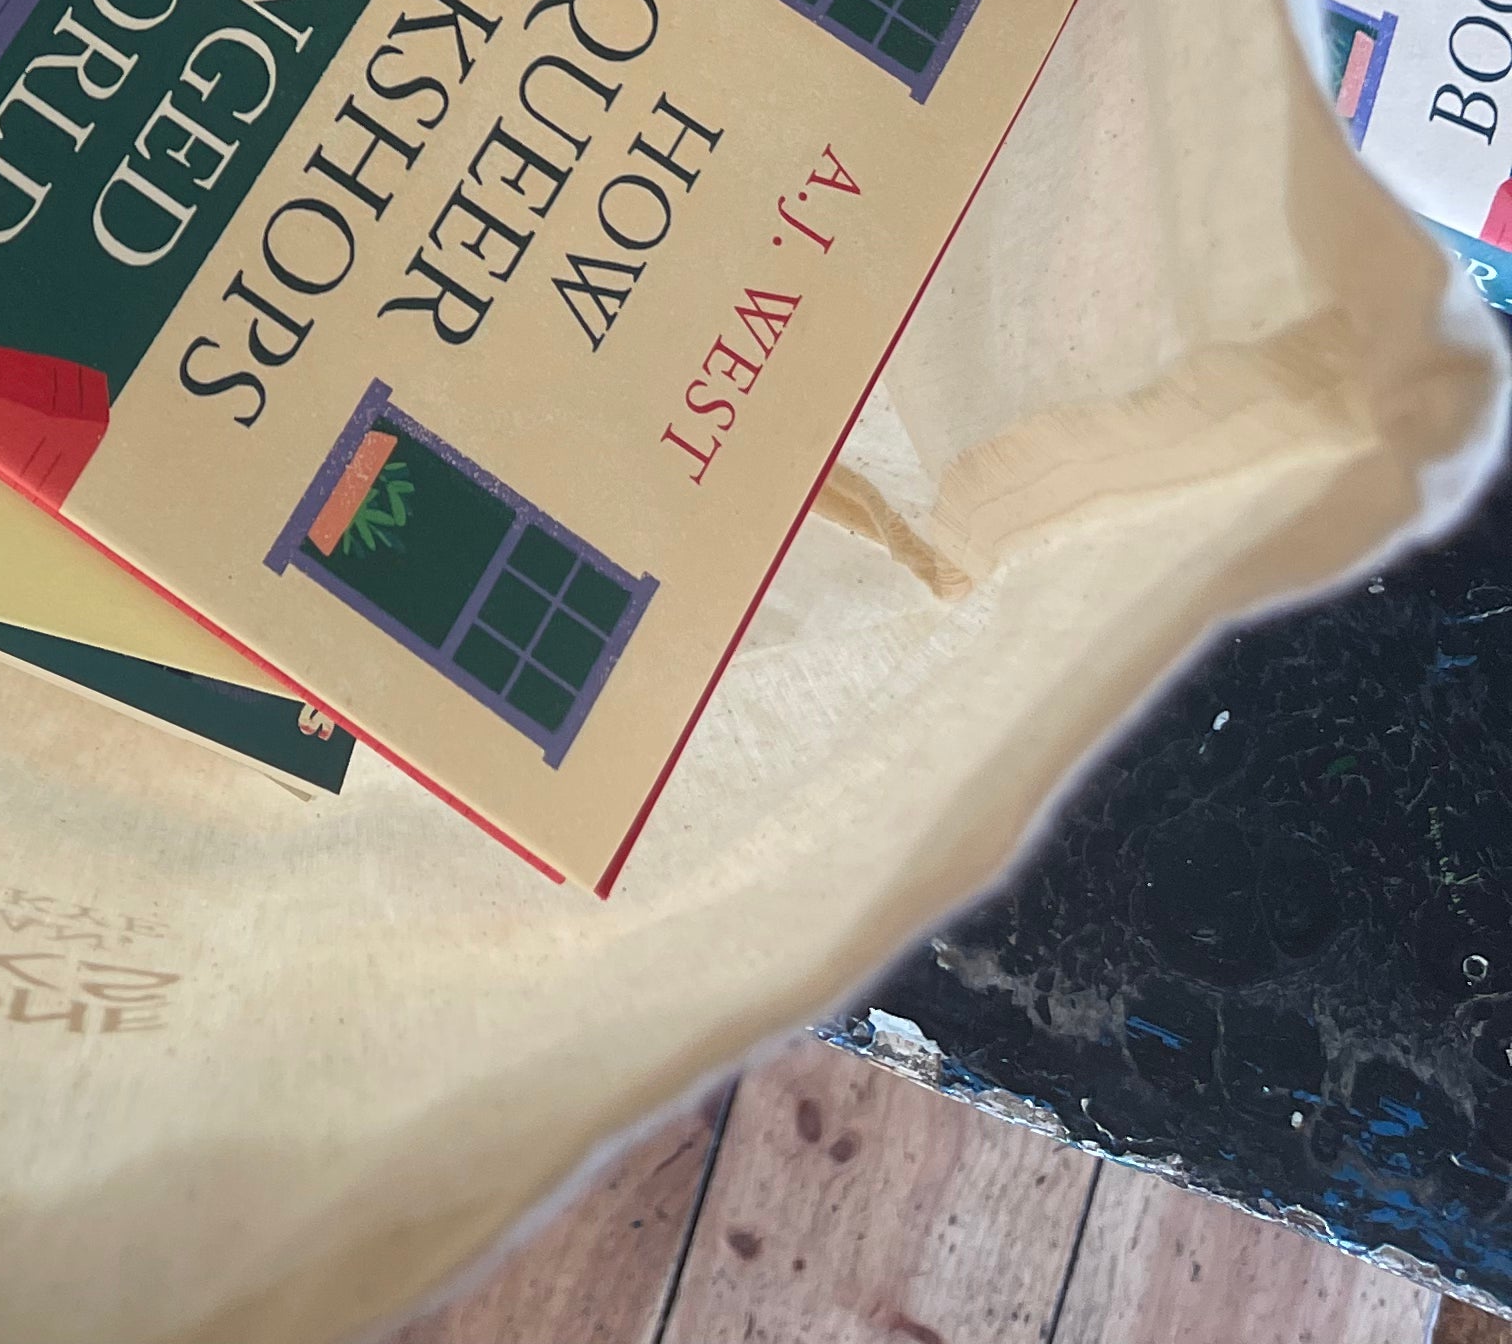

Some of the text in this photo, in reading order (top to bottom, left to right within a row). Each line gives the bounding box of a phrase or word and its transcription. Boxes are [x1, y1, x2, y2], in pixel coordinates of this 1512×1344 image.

[550, 91, 725, 353] HOW
[661, 141, 865, 486] A.J. WEST
